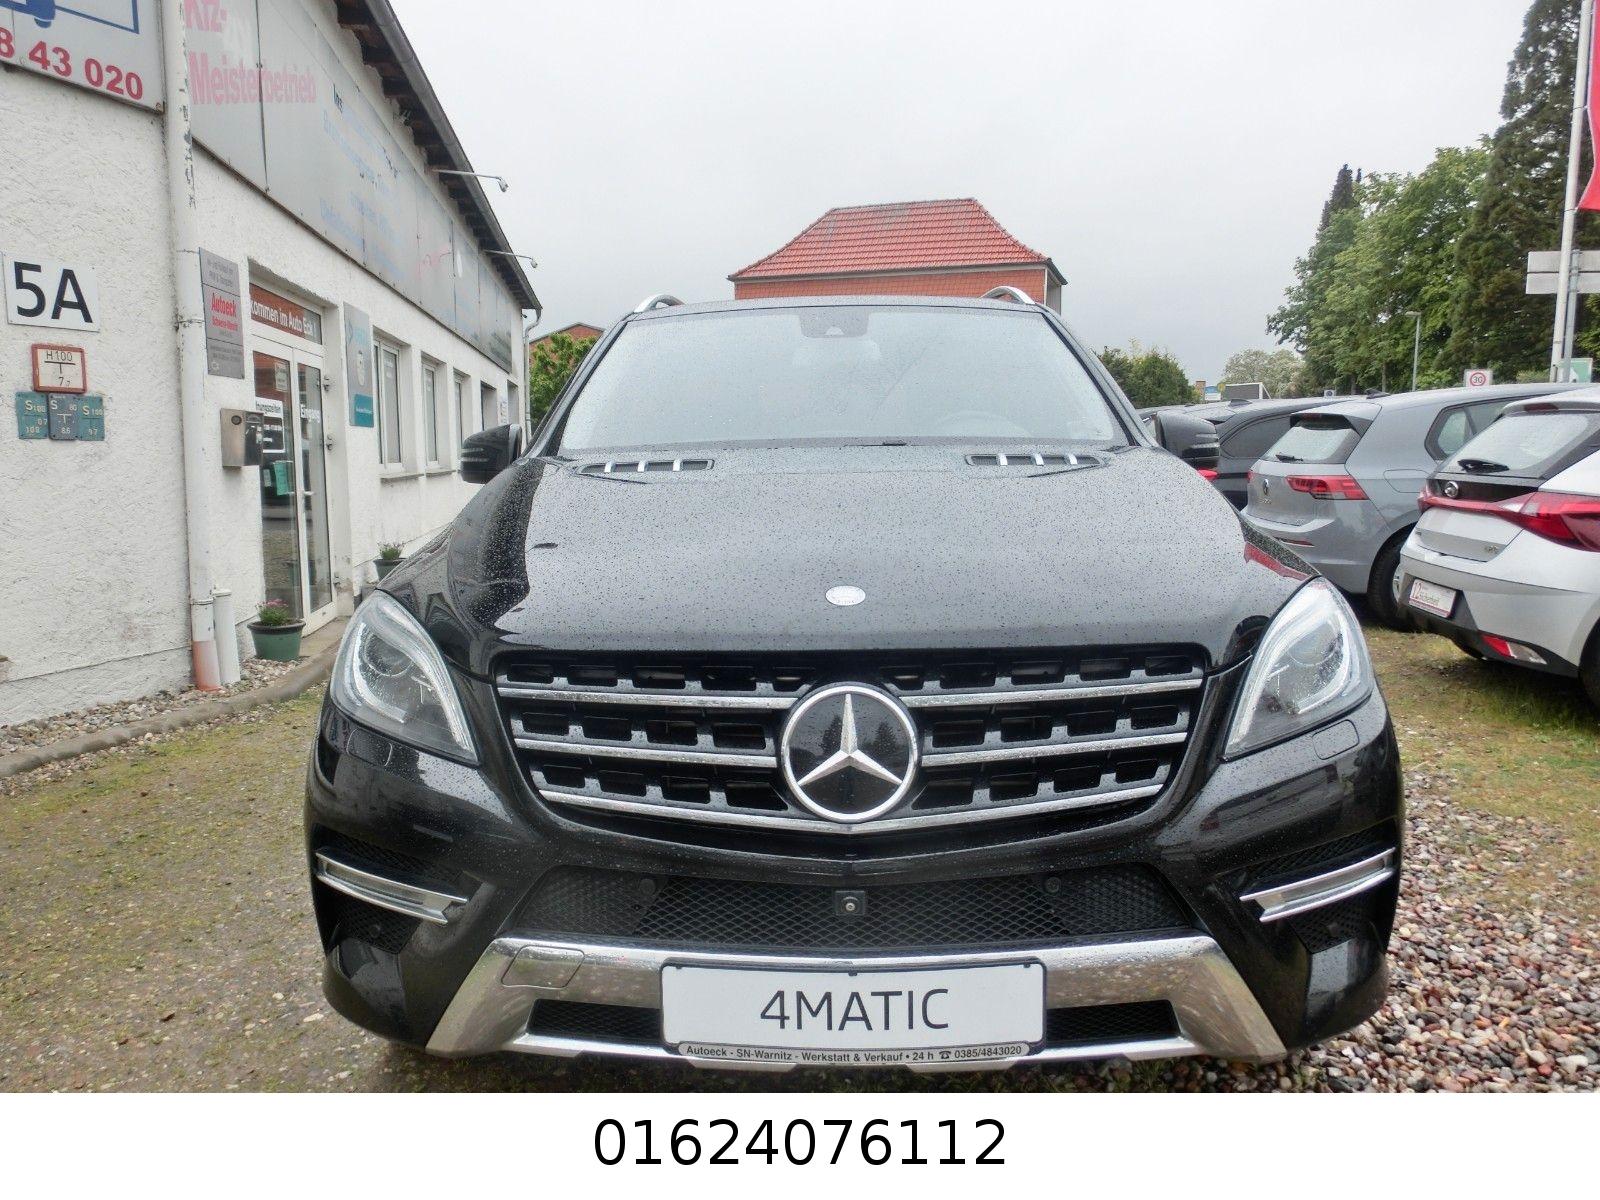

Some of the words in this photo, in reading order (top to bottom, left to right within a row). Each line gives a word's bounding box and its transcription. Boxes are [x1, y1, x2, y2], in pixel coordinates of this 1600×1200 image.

[28, 41, 72, 77] 43
[85, 58, 143, 100] 020
[14, 261, 93, 323] 5A
[760, 989, 949, 1031] 4MATIC
[686, 1045, 728, 1057] Autoeck
[736, 1048, 792, 1061] SN-Warnitz
[801, 1052, 850, 1062] Werkstatt
[864, 1053, 903, 1062] Verkauf
[912, 1052, 925, 1061] 24
[927, 1051, 934, 1060] h
[954, 1046, 1022, 1059] 0385/4843020
